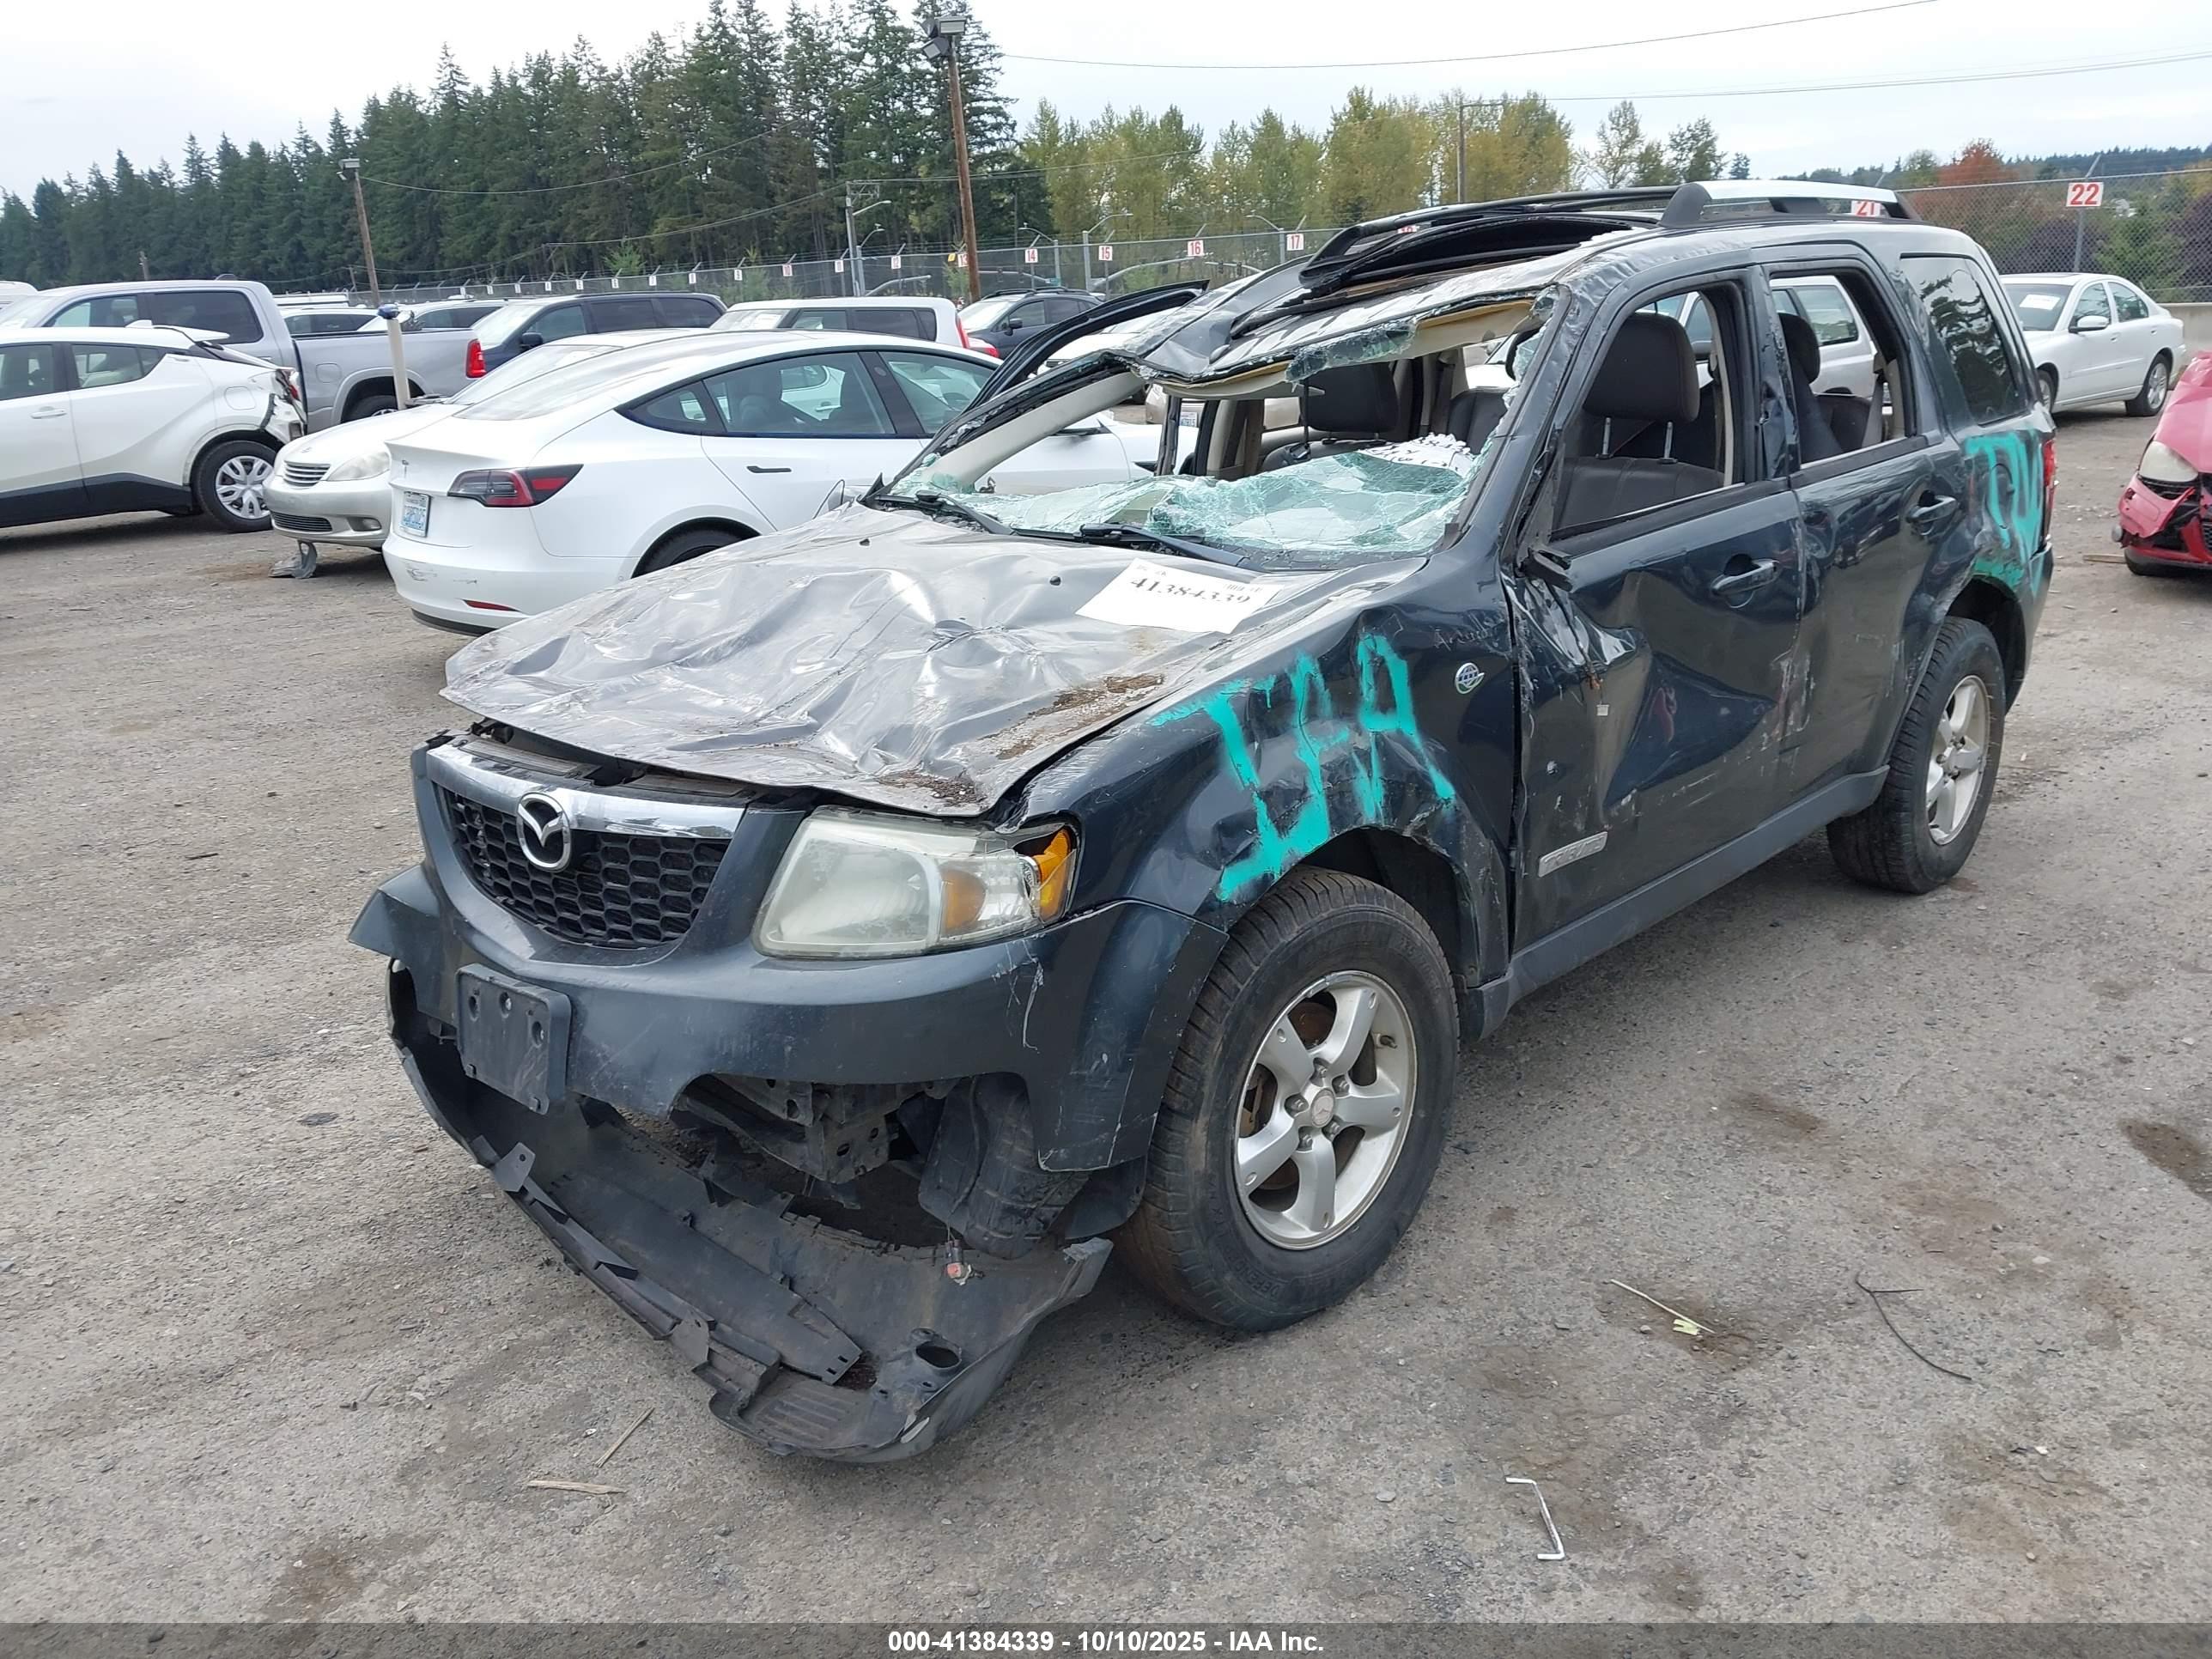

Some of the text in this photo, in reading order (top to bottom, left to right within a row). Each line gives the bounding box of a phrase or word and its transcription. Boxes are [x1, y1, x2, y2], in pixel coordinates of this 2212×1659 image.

[2070, 183, 2100, 205] 22
[1856, 200, 1875, 216] 21
[1190, 241, 1201, 255] 16
[1291, 234, 1300, 249] 17
[1026, 249, 1036, 262] 14
[1101, 246, 1110, 259] 15
[1130, 577, 1251, 603] 41384339
